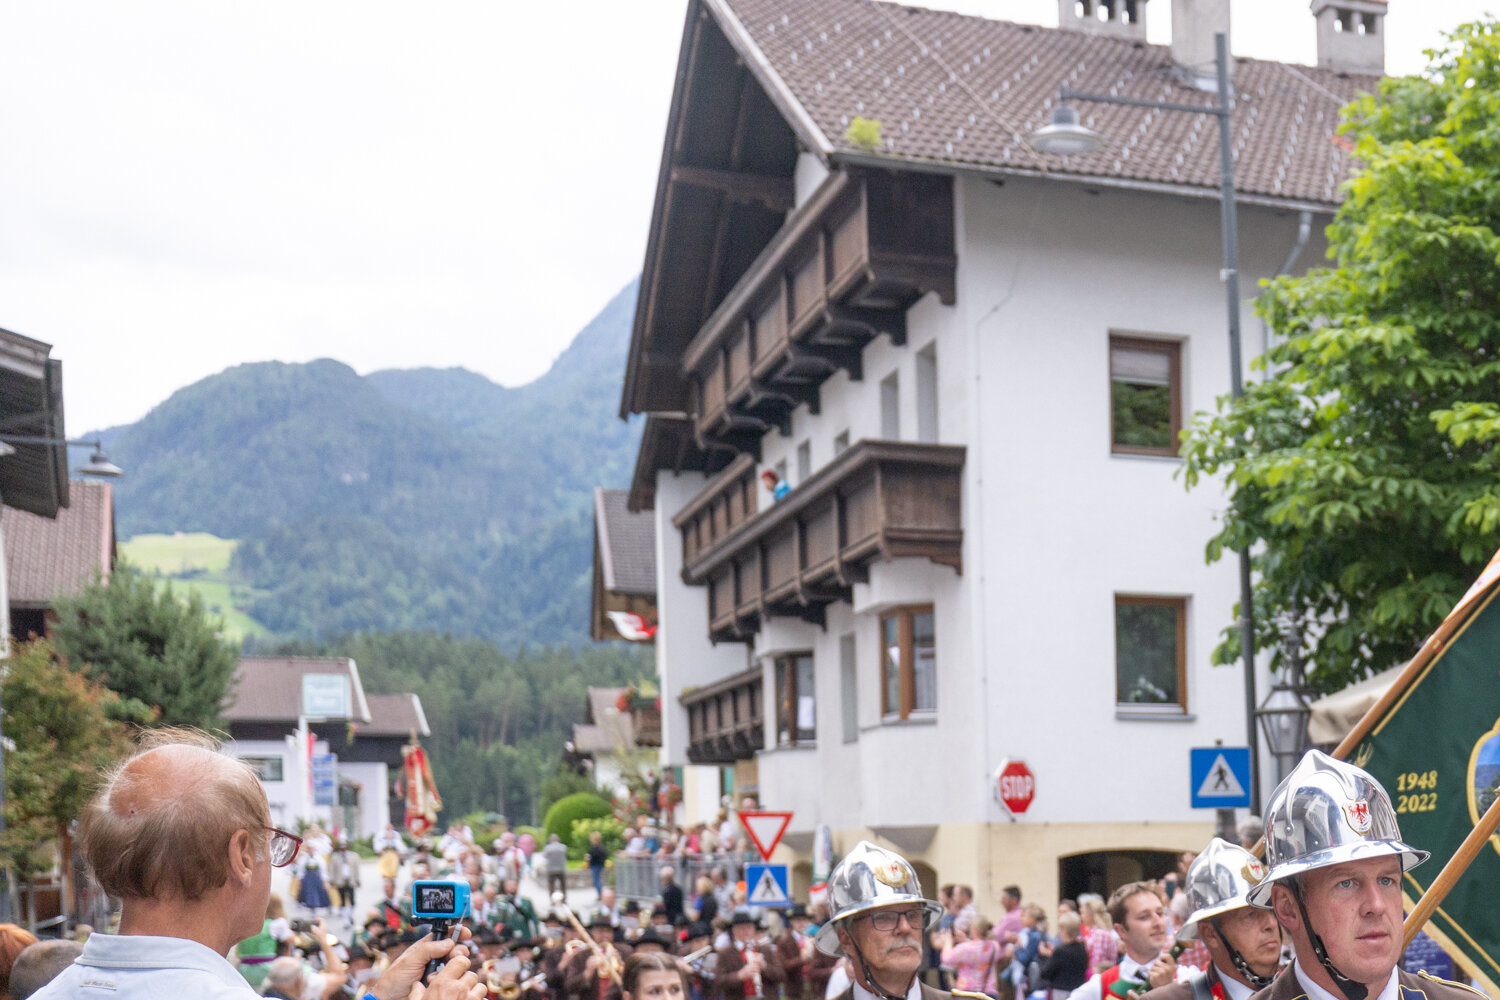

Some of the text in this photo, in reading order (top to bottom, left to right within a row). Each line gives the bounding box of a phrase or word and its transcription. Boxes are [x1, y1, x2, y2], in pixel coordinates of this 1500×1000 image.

[1002, 775, 1032, 798] STOP
[1397, 770, 1438, 791] 1948
[1396, 792, 1438, 813] 2022
